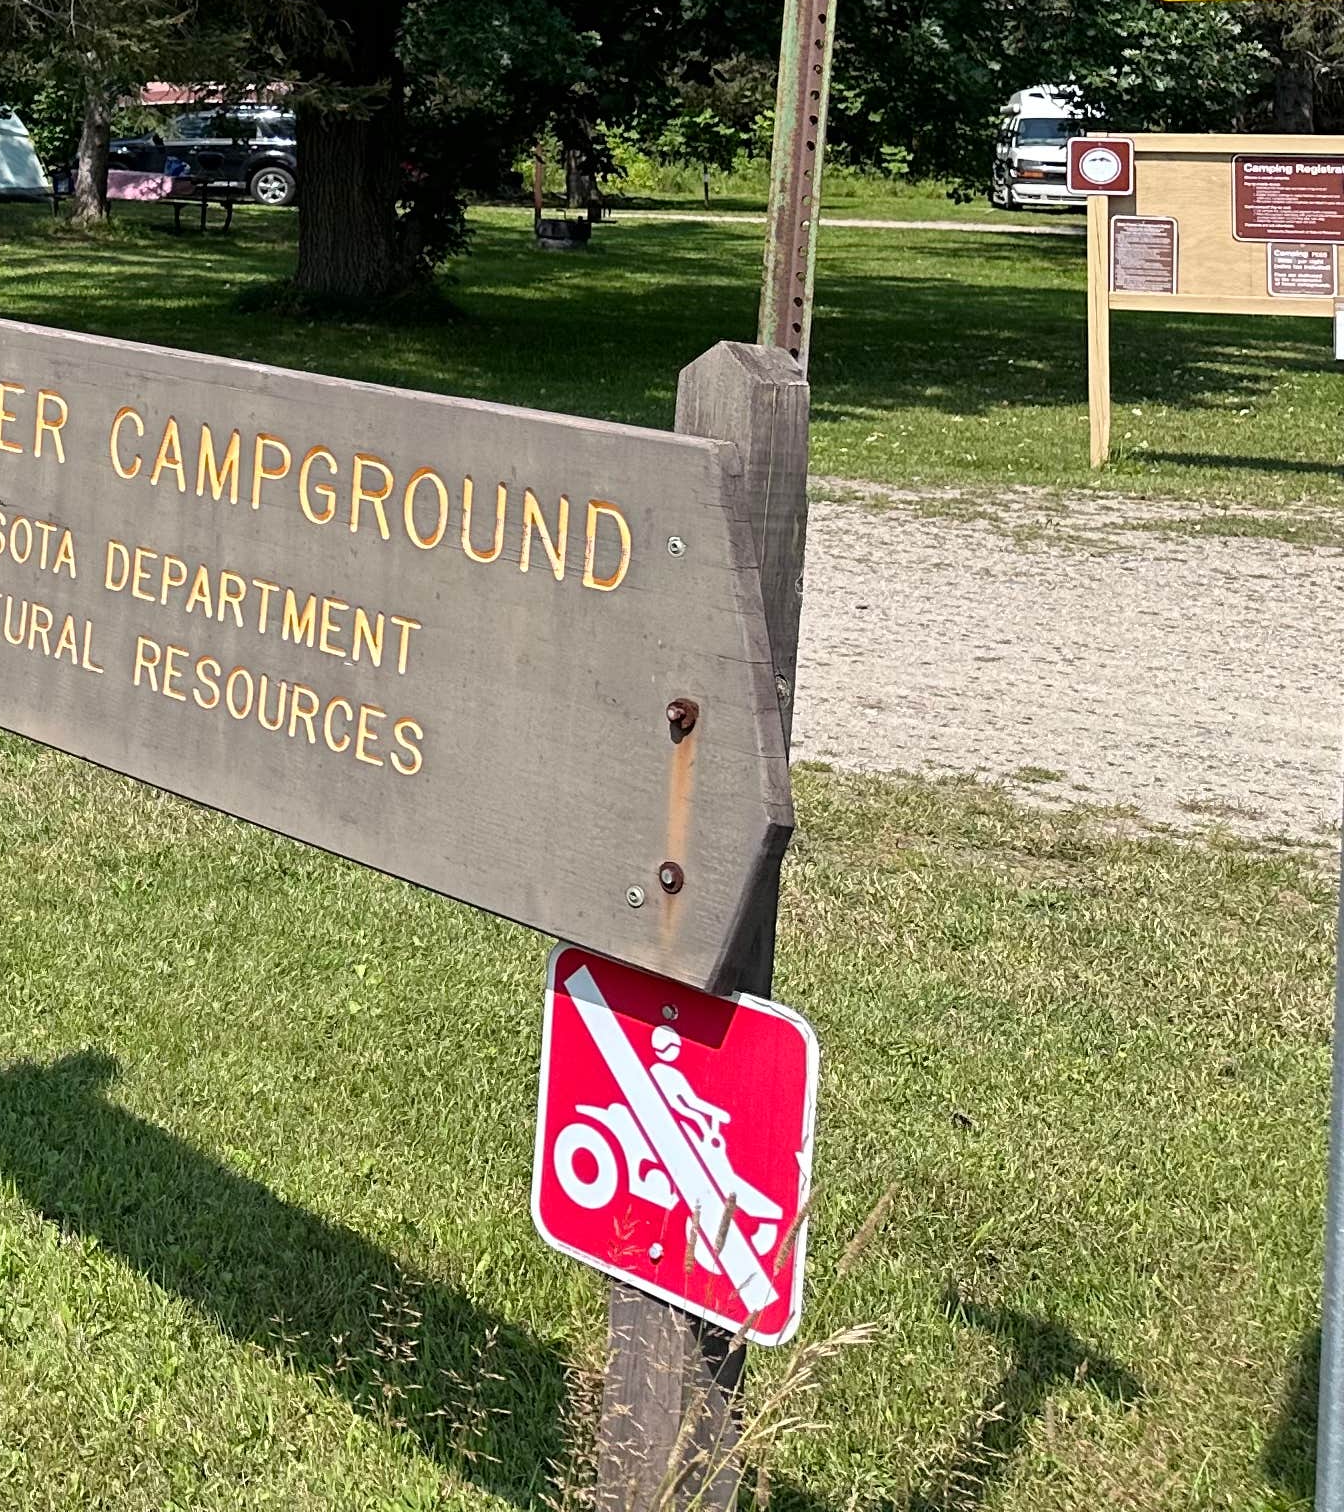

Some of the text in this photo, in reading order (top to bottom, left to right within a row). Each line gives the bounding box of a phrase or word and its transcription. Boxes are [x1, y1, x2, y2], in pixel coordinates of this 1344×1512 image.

[1243, 163, 1293, 175] Camping
[108, 406, 635, 593] CAMPGROUND
[103, 540, 423, 675] DEPARTMENT
[131, 636, 427, 776] RESOURCES
